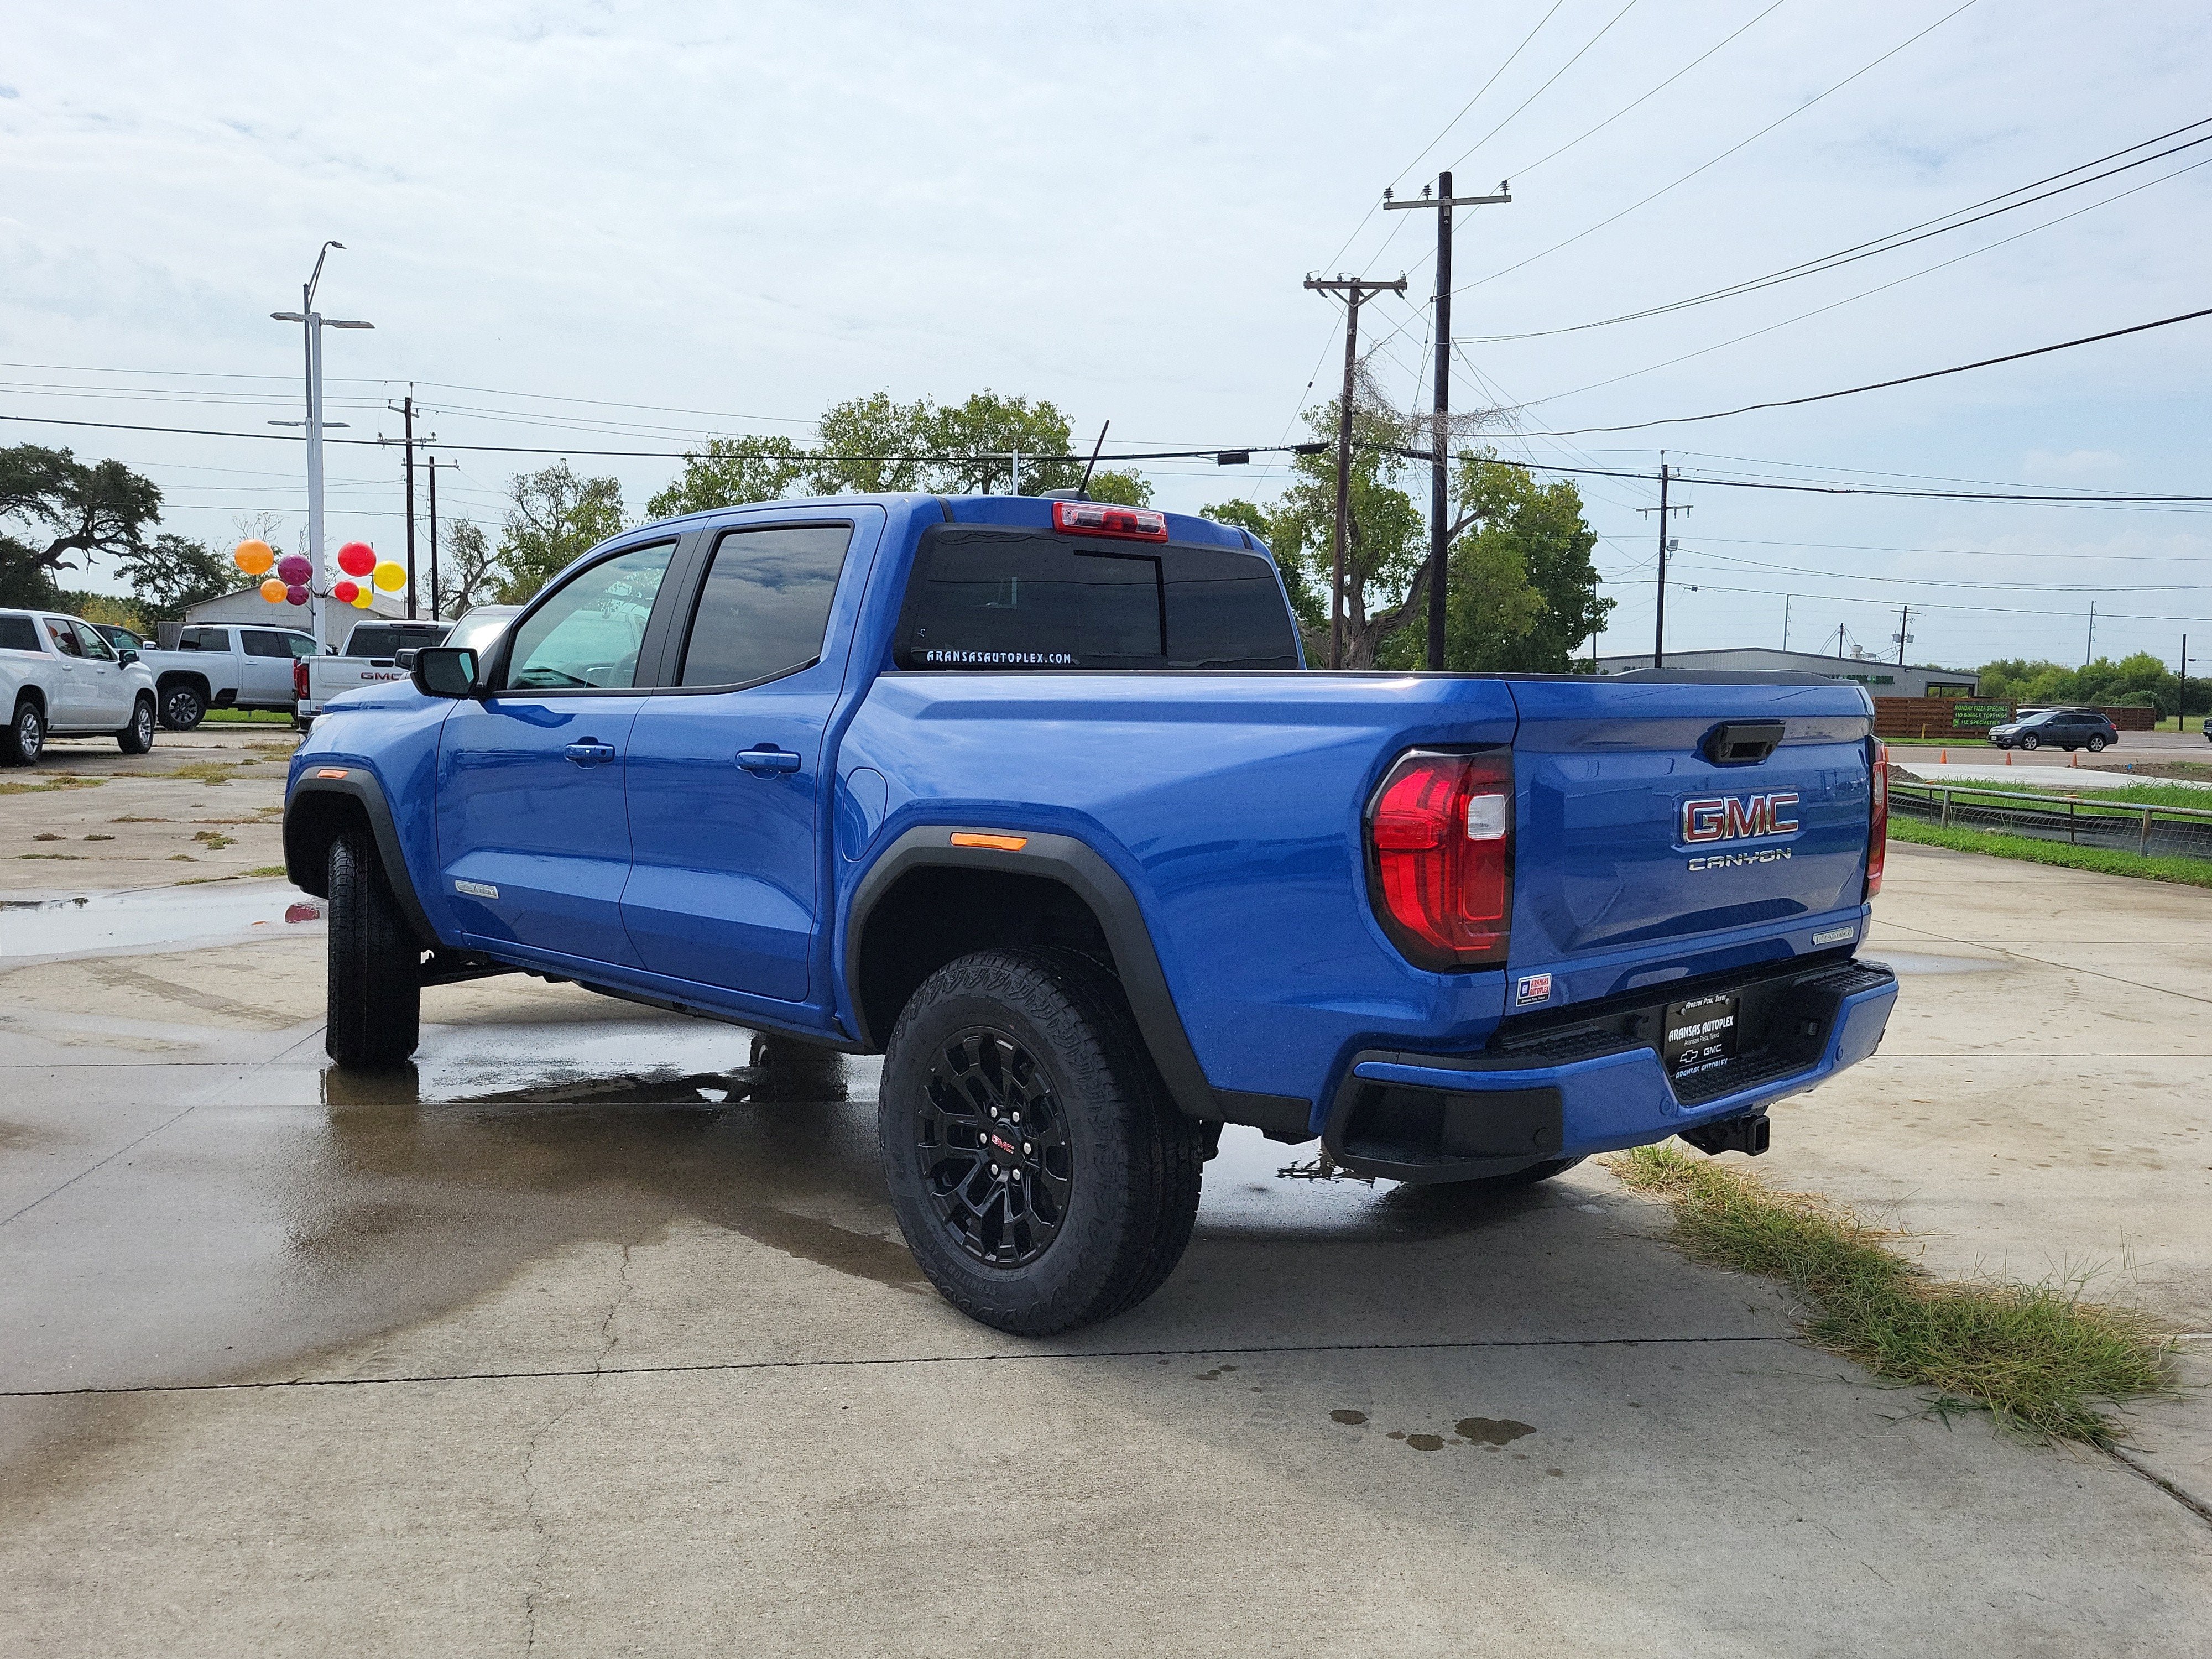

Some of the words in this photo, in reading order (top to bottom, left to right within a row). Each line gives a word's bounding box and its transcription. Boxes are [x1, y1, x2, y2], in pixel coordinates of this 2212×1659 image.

[927, 650, 1071, 664] ARANSASAUTOPLEX.COM
[361, 672, 403, 680] GMC
[1683, 792, 1799, 843] GMC
[1688, 847, 1792, 872] CANYON
[1529, 986, 1548, 996] AUTOPLEX
[1715, 994, 1726, 1003] Texas
[1668, 1023, 1700, 1042] ARANSAS
[1702, 1015, 1734, 1033] AUTOPLEX
[1684, 1038, 1699, 1046] Aransas
[1704, 1044, 1722, 1056] GMC
[992, 1134, 1015, 1154] GMC
